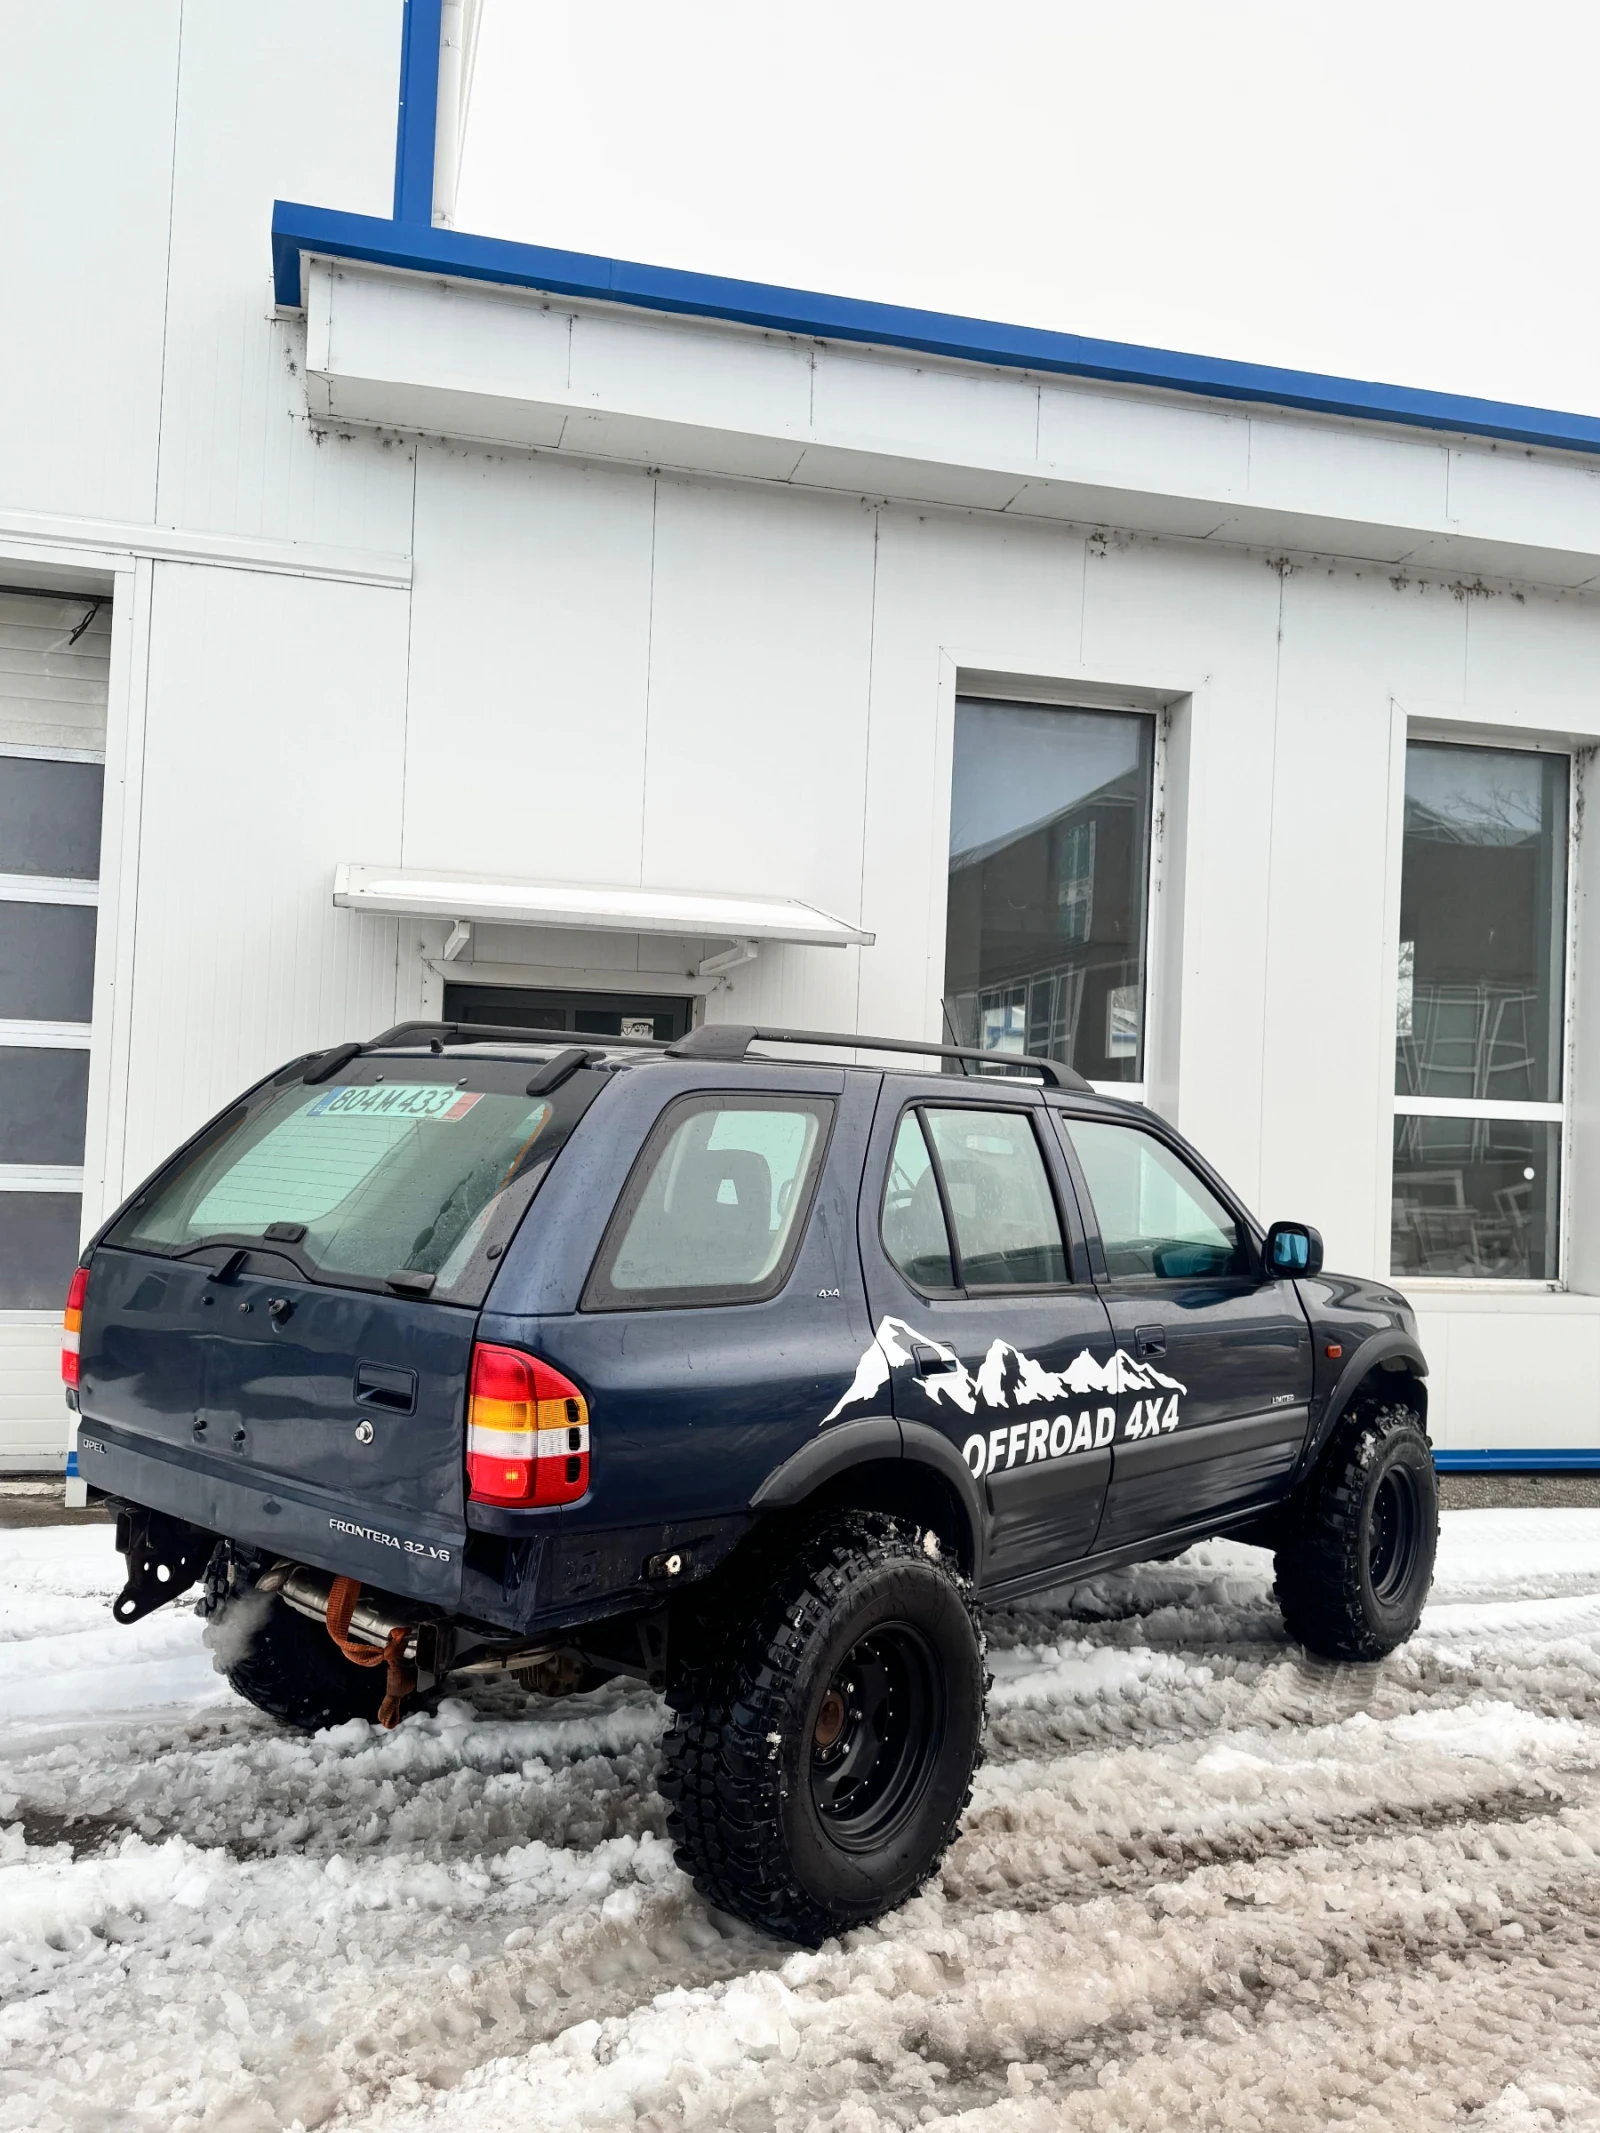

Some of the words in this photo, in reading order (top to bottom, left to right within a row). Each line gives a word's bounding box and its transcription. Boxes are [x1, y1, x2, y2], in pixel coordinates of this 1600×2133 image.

[83, 1439, 106, 1454] OPEL
[963, 1407, 1116, 1480] OFFROAD
[1125, 1394, 1179, 1440] 4X4
[329, 1518, 401, 1549] FRONTERA
[429, 1546, 450, 1562] V6
